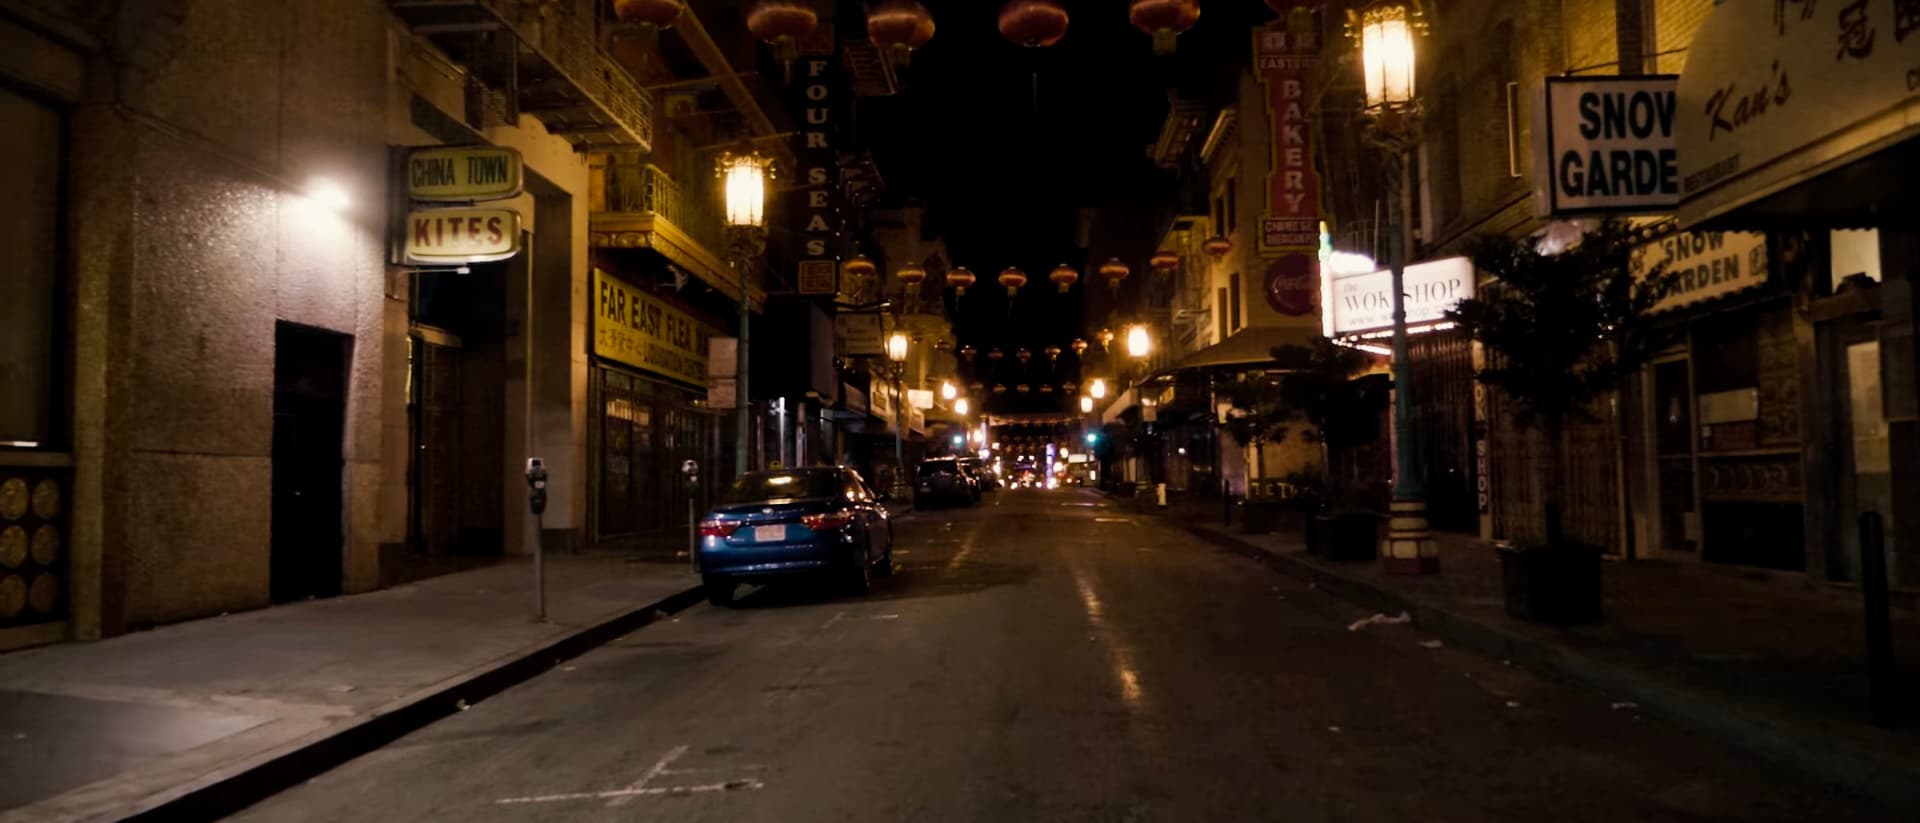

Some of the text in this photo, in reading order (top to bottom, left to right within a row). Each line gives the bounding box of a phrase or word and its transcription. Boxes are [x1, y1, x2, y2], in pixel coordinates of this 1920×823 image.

[806, 60, 829, 149] FOUR
[1706, 59, 1791, 141] Kan's
[411, 155, 508, 188] CHINA TOWN
[1282, 79, 1305, 214] BAKERY
[414, 216, 502, 247] KITES
[805, 168, 829, 256] SEAS
[1665, 228, 1723, 264] SNOW
[1344, 277, 1461, 312] WOK SHOP
[1657, 254, 1738, 296] ARDEN
[600, 280, 626, 326] FAR
[632, 295, 661, 341] EAST
[667, 313, 692, 353] FLEA
[1474, 384, 1487, 513] OK SHOP
